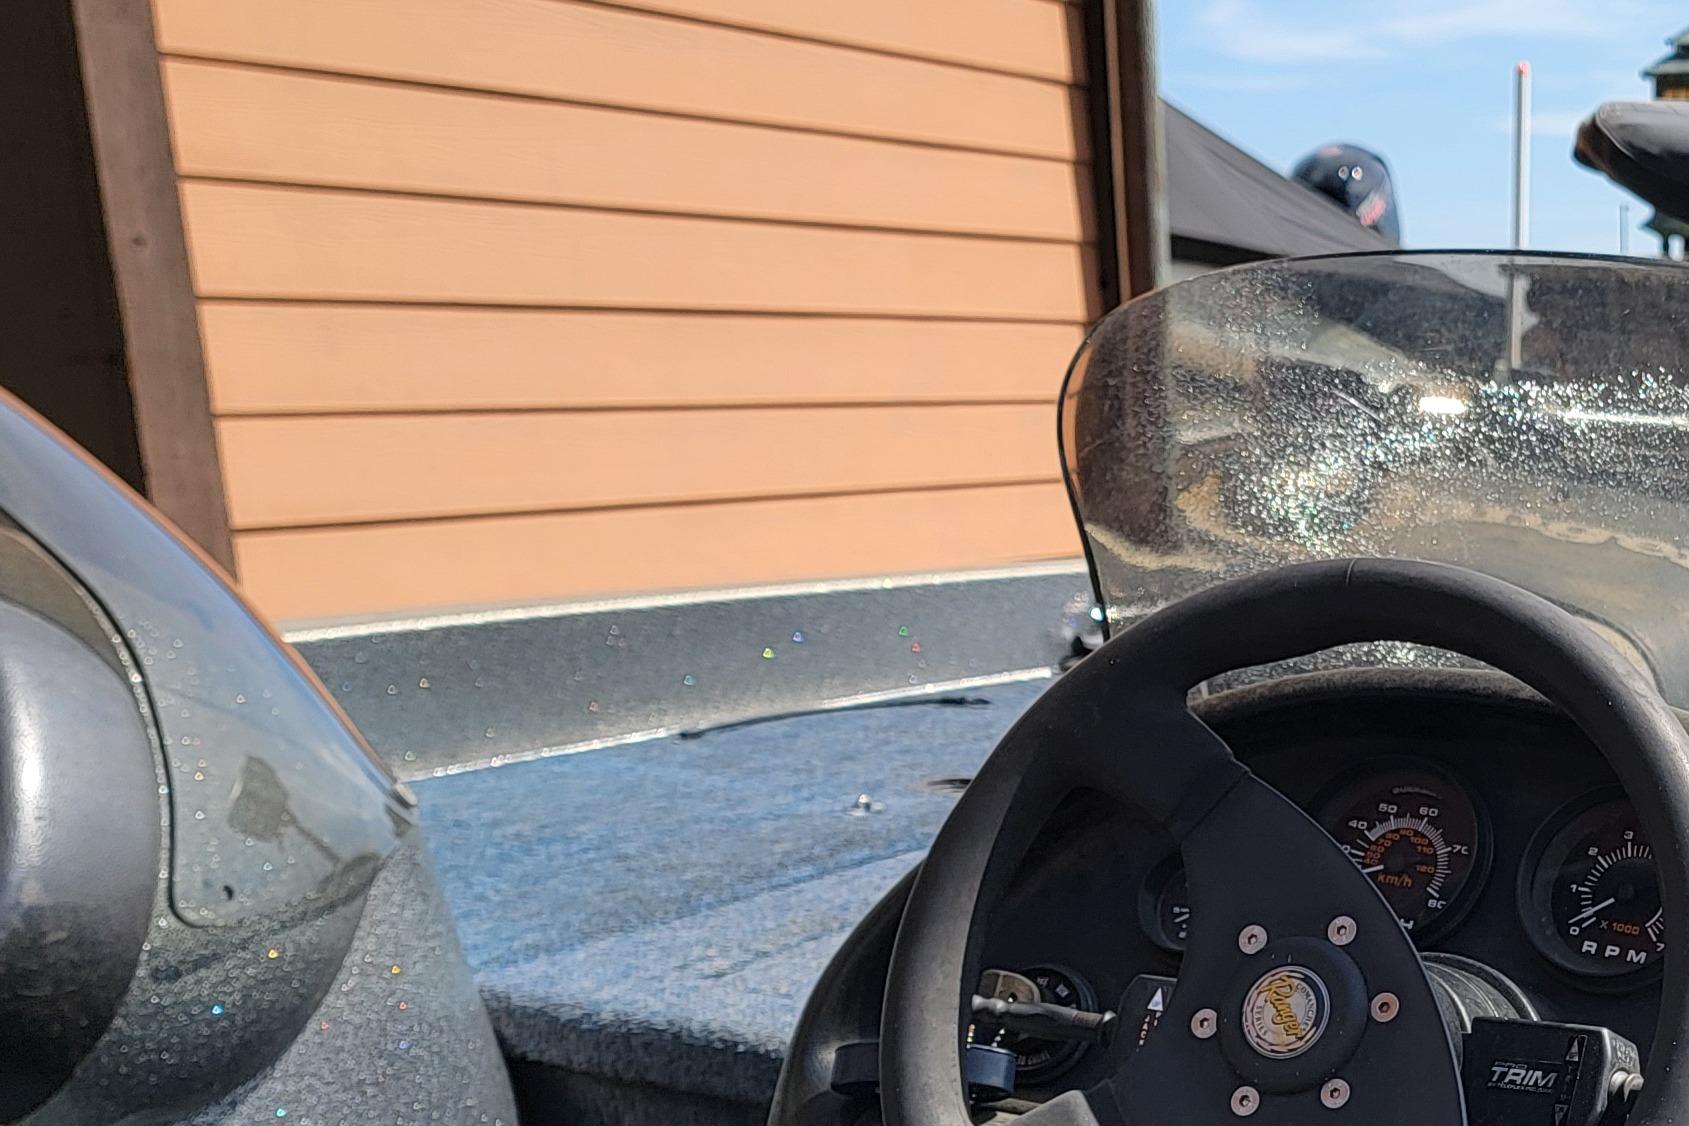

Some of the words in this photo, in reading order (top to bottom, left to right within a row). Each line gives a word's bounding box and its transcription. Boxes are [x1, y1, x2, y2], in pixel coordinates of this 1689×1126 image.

[1378, 803, 1398, 814] 50
[1419, 806, 1439, 817] 60
[1348, 819, 1368, 830] 40
[1623, 830, 1634, 840] 3
[1588, 847, 1599, 856] 2
[1416, 865, 1435, 874] 120
[1377, 873, 1413, 888] km/h
[1570, 884, 1577, 893] 1
[1569, 926, 1579, 936] 0
[1612, 922, 1640, 935] 1000
[1655, 942, 1665, 952] 7
[1490, 1066, 1560, 1088] TRIM
